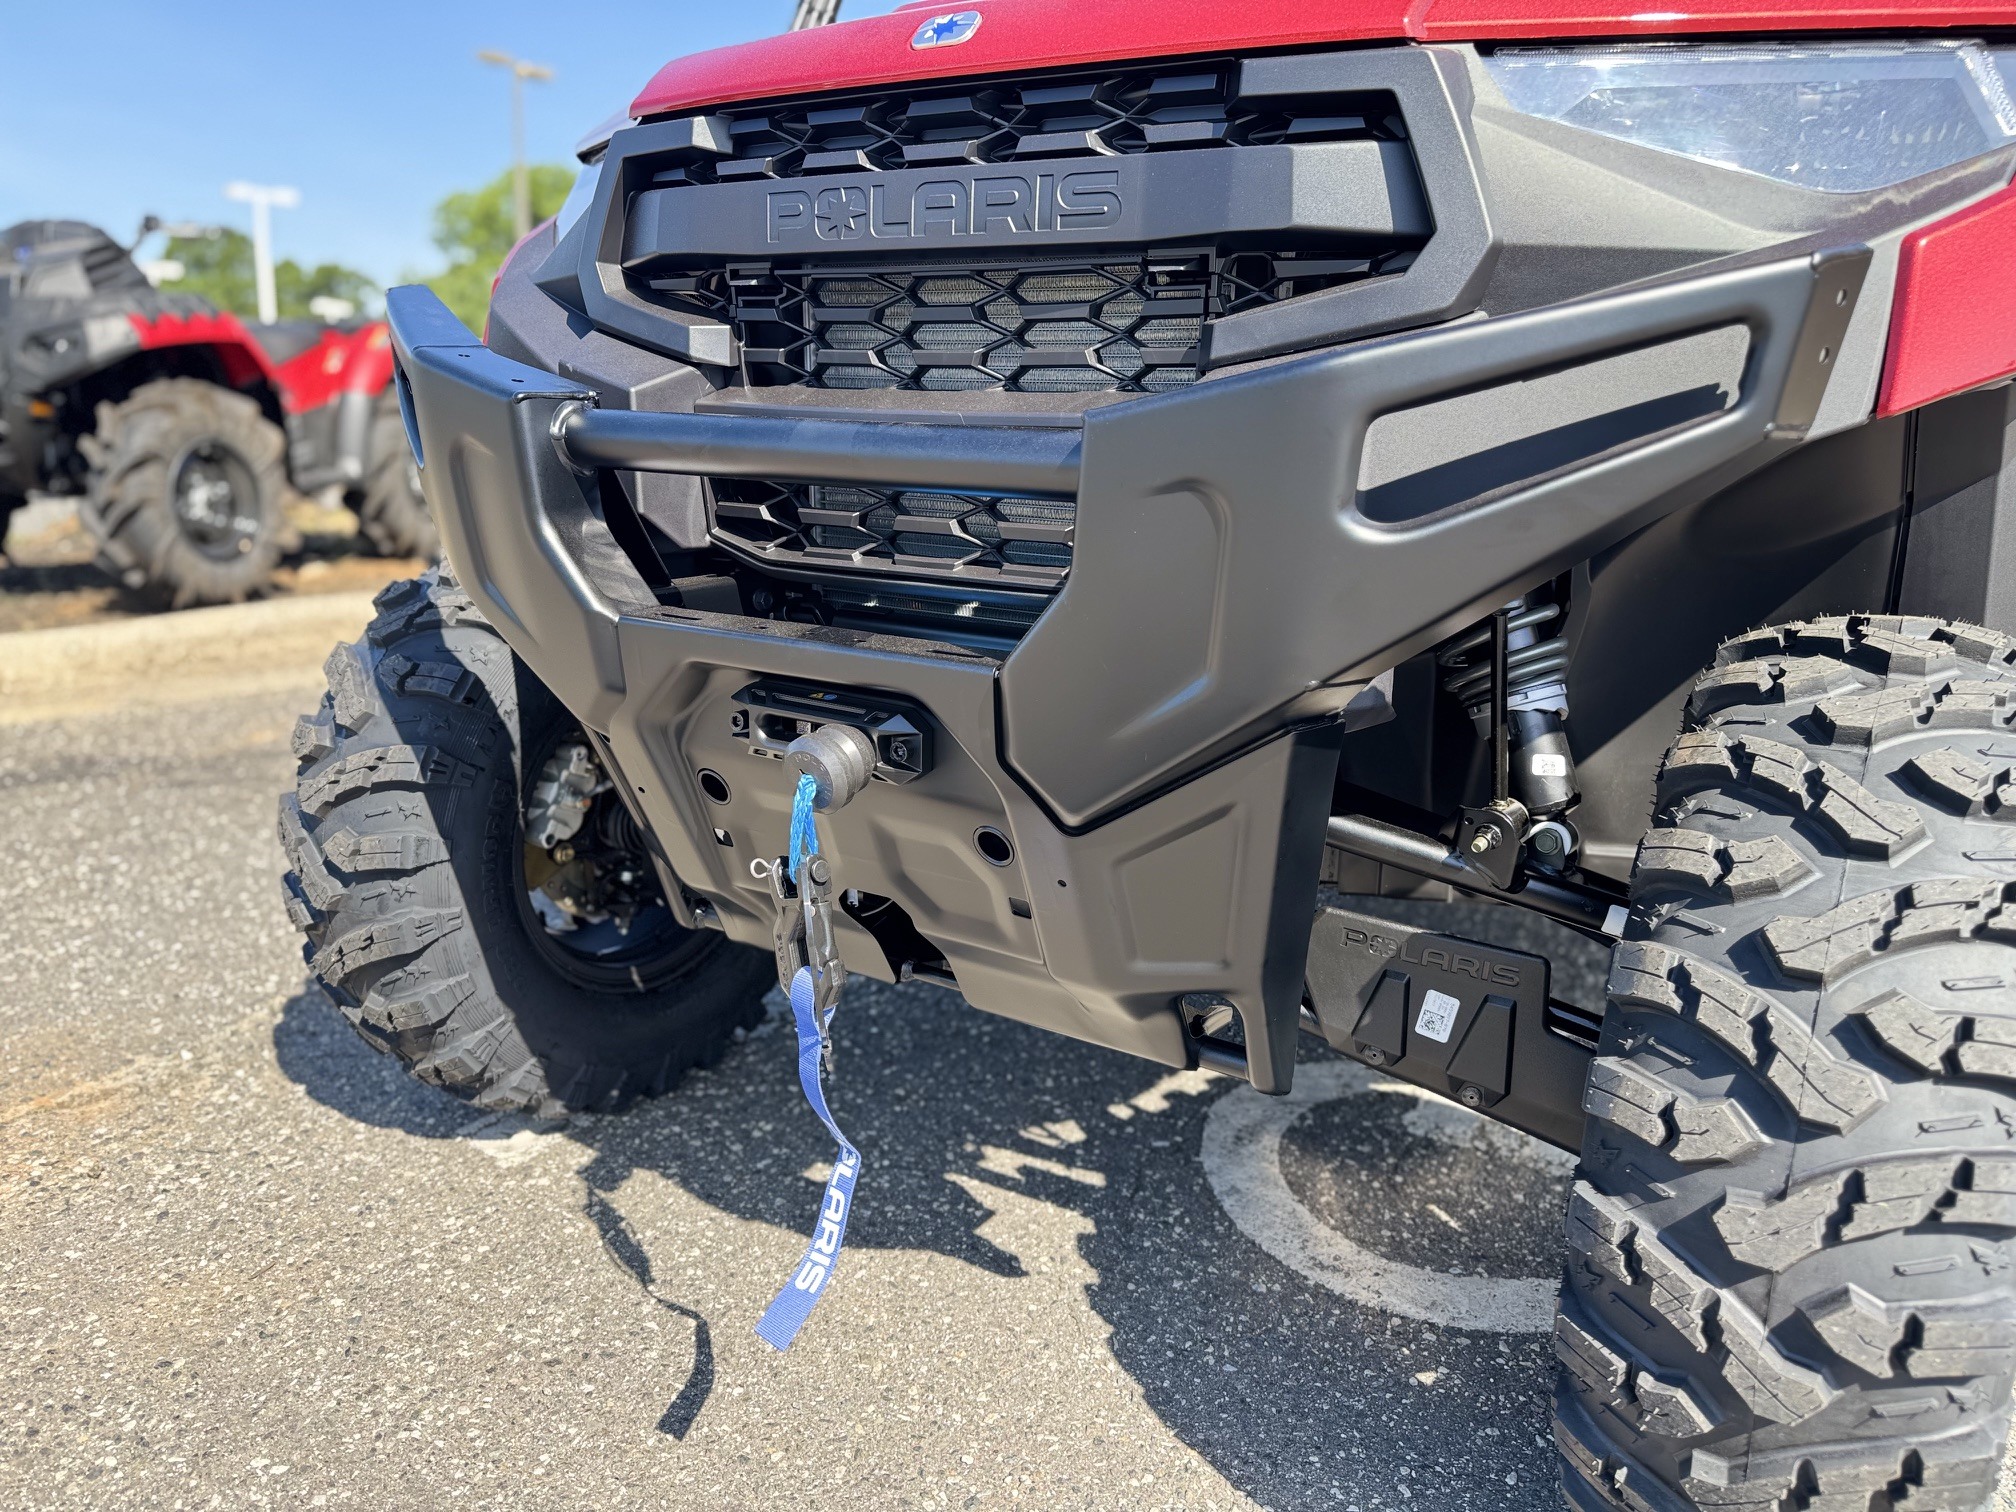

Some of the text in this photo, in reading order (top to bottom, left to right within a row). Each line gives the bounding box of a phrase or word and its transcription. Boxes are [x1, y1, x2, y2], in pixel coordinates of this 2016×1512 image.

[767, 171, 1122, 243] POLARIS
[1340, 926, 1520, 988] POLARIS
[794, 1144, 858, 1295] OLARIS
